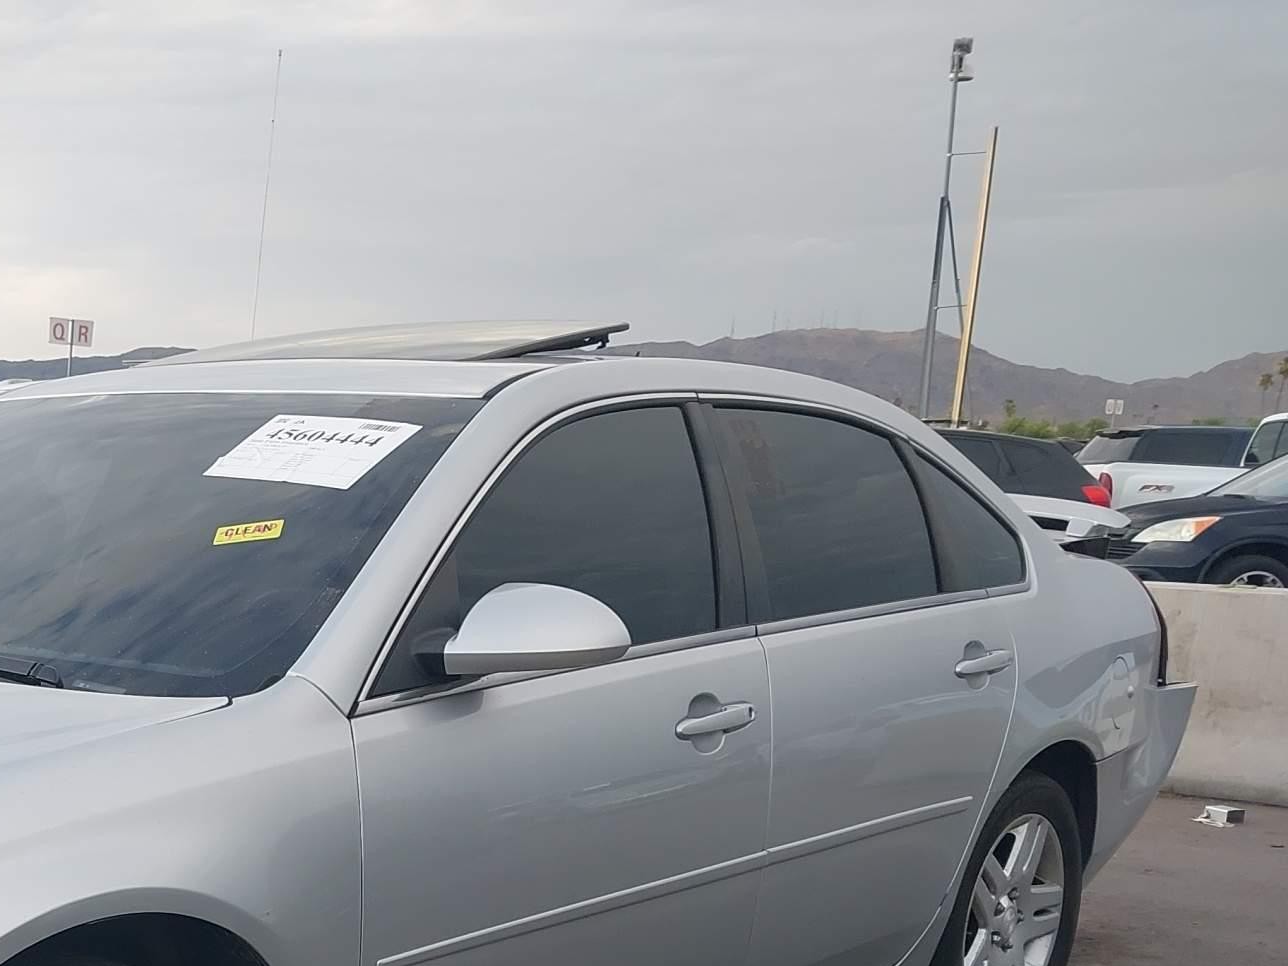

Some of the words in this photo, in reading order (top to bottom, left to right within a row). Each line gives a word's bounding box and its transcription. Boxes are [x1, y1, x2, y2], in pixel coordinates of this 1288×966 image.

[53, 323, 65, 341] Q
[78, 325, 89, 343] R
[266, 429, 384, 447] 45604444
[224, 523, 272, 537] CLEAN
